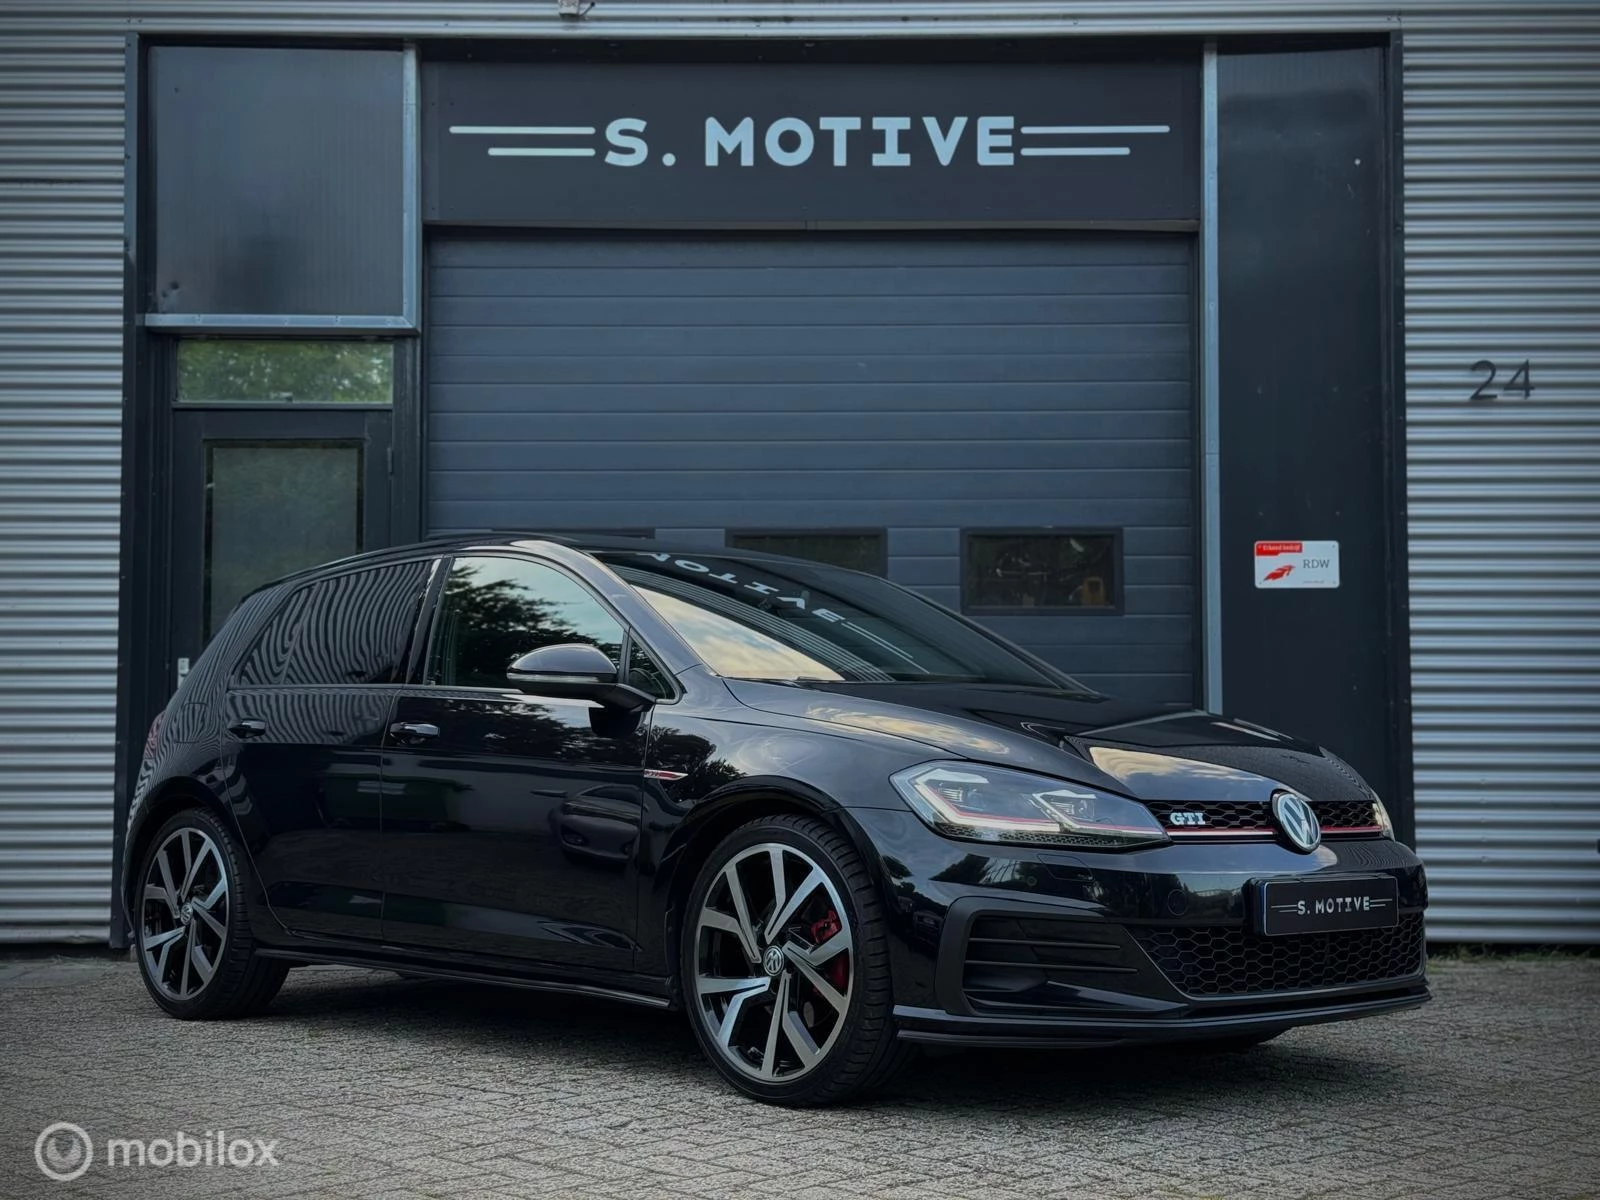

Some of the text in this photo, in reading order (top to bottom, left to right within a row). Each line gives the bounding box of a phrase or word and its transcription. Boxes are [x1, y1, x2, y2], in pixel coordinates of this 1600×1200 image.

[604, 115, 1015, 167] S. MOTIVE
[1469, 359, 1535, 400] 24
[1303, 559, 1330, 569] RDW
[1169, 812, 1206, 826] GTI
[1298, 896, 1370, 915] S. MOTIVE
